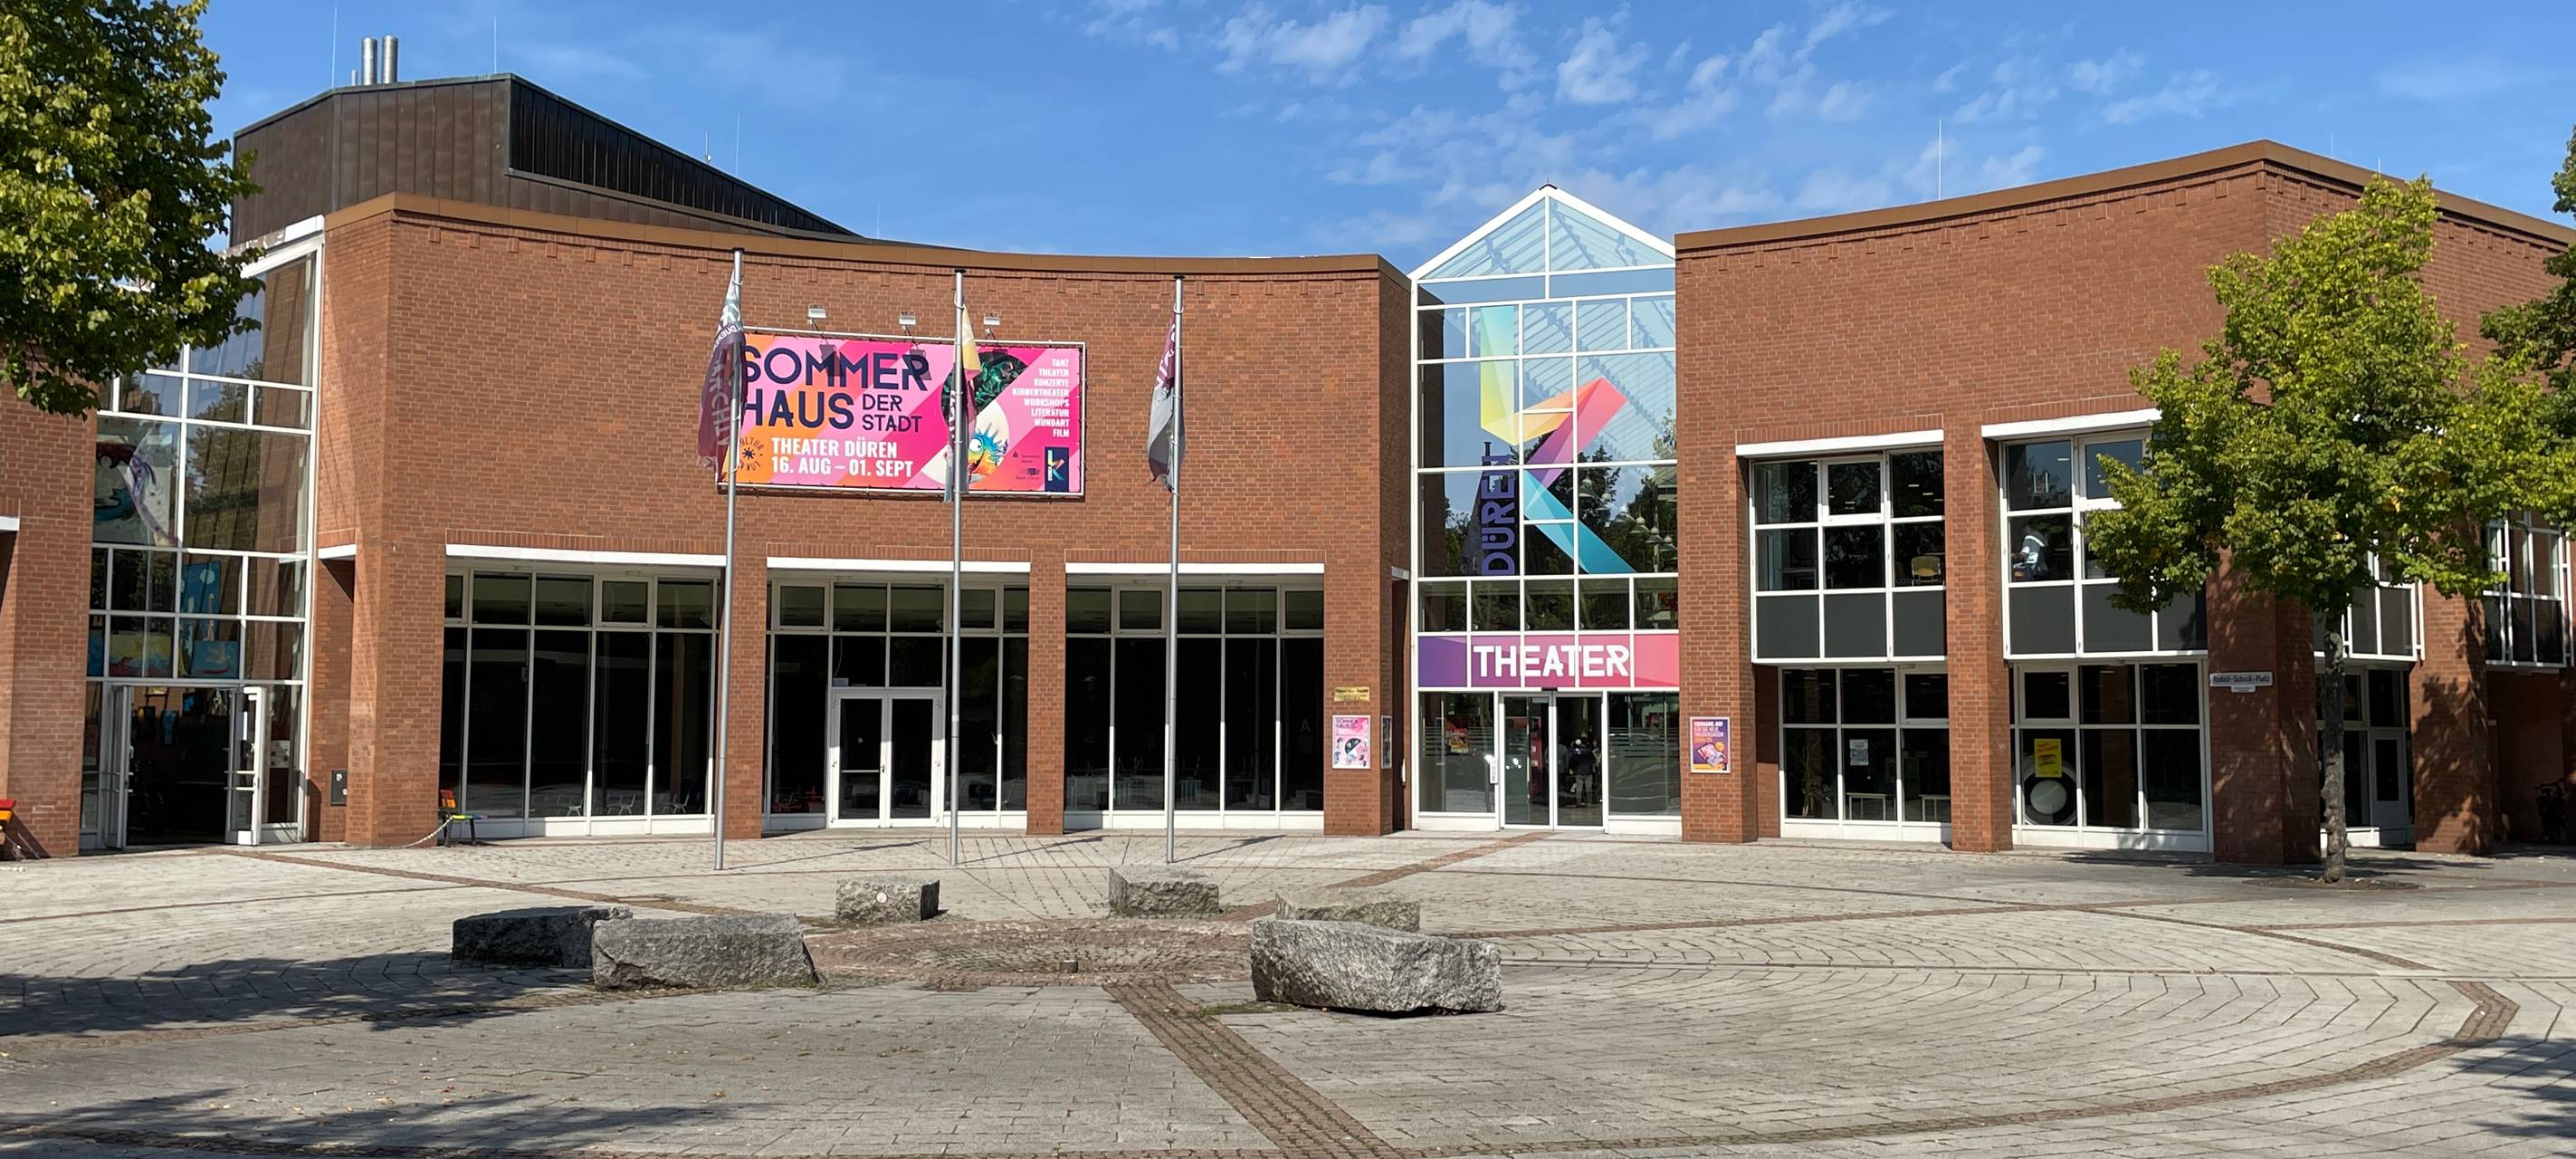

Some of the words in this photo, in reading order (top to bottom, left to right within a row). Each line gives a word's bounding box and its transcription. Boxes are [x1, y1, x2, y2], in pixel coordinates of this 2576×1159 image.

[1052, 359, 1069, 367] TANZ
[745, 346, 928, 391] SOMMER
[1039, 369, 1069, 377] THEATER
[1034, 378, 1069, 387] KONZERTE
[1024, 398, 1070, 407] WORKSHOPS
[746, 388, 854, 429] HAUS
[863, 394, 902, 411] DER
[1031, 408, 1070, 417] LITERATUR
[863, 414, 922, 433] STADT
[1035, 418, 1070, 426] MUNDART
[1053, 428, 1070, 437] FILM
[771, 436, 840, 456] THEATER
[844, 436, 898, 459] DÜREN
[772, 456, 795, 474] 16.
[798, 458, 831, 475] AUG
[849, 459, 872, 477] 01.
[875, 460, 913, 478] SEPT
[1474, 644, 1630, 677] THEATER
